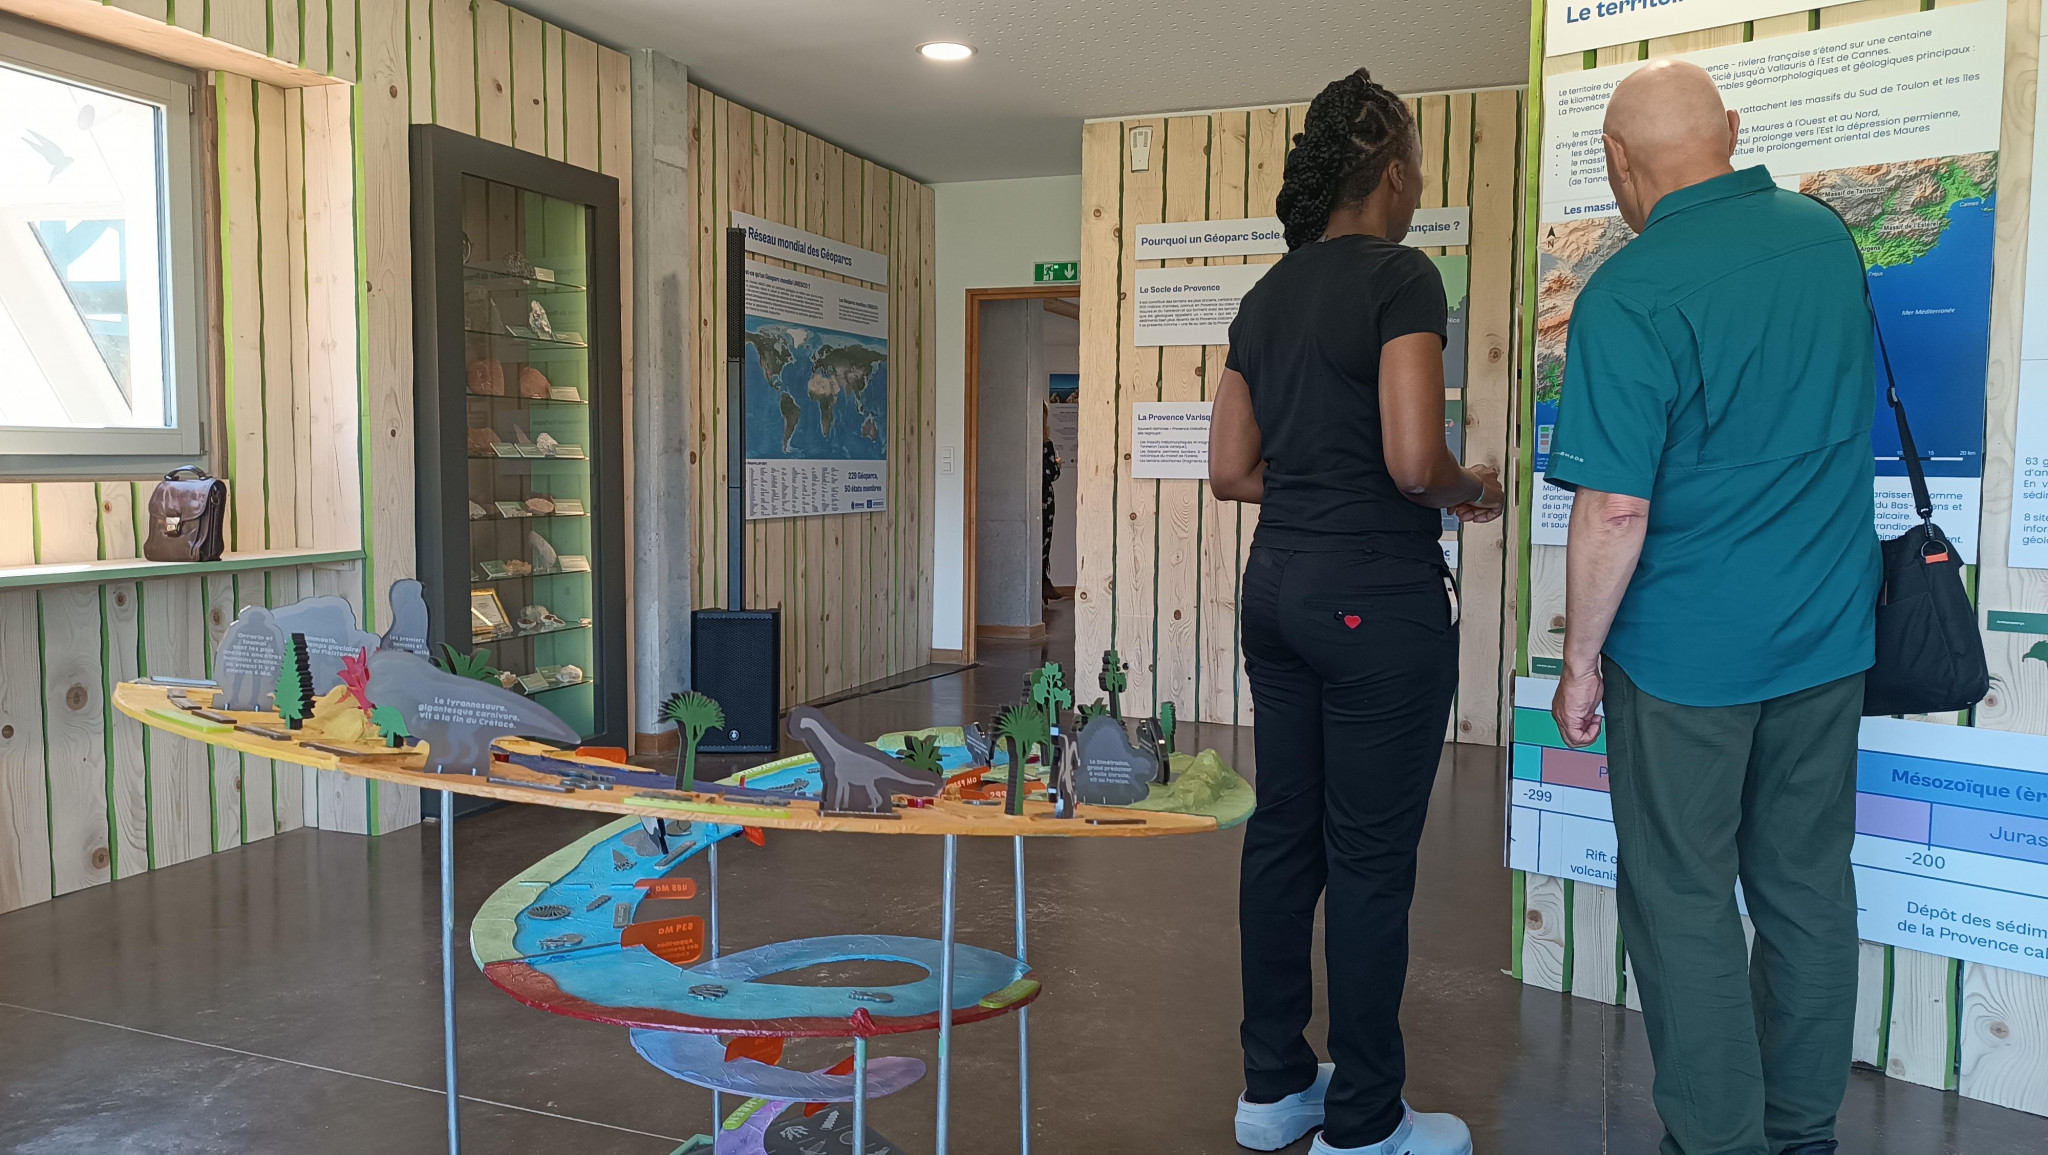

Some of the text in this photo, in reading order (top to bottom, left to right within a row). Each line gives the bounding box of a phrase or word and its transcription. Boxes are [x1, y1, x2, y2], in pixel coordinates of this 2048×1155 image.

[1567, 6, 1591, 24] Le
[1738, 29, 1932, 68] riviera française s'étend sur une centaine
[1768, 60, 1806, 73] Vallauris
[1808, 58, 1815, 67] à
[1836, 53, 1849, 63] de
[1851, 48, 1891, 60] Cannes.
[1746, 46, 1970, 89] géomorphologiques et géologiques principaux
[1558, 80, 1613, 97] Le territoire du
[1740, 73, 1980, 114] rattachent les massifs du Sud de Toulon et les îles
[1558, 92, 1611, 107] de kilomètres
[1568, 103, 1605, 114] Provence
[1751, 108, 1880, 133] Maures à l'Ouest et au Nord,
[1752, 132, 1793, 145] prolonge
[1795, 128, 1814, 137] vers
[1835, 124, 1845, 132] la
[1846, 117, 1901, 132] dépression
[1903, 109, 1961, 125] permienne,
[1572, 130, 1579, 138] le
[1756, 124, 1930, 154] le prolongement oriental des Maures
[1571, 147, 1582, 157] les
[1570, 159, 1578, 167] le
[1570, 164, 1605, 177] le massif
[1568, 177, 1582, 188] (de
[1824, 190, 1845, 198] Massif
[1855, 186, 1886, 195] Tanneron
[1563, 205, 1582, 216] Les
[1453, 221, 1461, 231] ?
[1883, 223, 1903, 232] Massif
[1141, 230, 1280, 247] Pourquoi un Géoparc Socle
[1547, 240, 1554, 249] N
[748, 226, 853, 267] Réseau mondial des Géoparcs
[1139, 284, 1221, 294] Le Socle de Provence
[1902, 309, 1914, 317] Mer
[1137, 413, 1147, 421] La
[1148, 413, 1185, 421] Provence
[2025, 456, 2039, 466] 63
[2023, 479, 2036, 488] En
[1542, 502, 1560, 511] de la
[1875, 501, 1962, 511] du et
[1547, 511, 1567, 521] s'agit
[2023, 513, 2031, 522] 8
[1541, 521, 1549, 529] et
[434, 696, 445, 705] Le
[418, 703, 473, 716] gigantesque
[419, 711, 432, 720] vit
[433, 712, 440, 720] à
[441, 713, 451, 721] la
[452, 714, 464, 723] fin
[466, 716, 477, 724] du
[1891, 768, 2011, 798] Mésozoïque
[1523, 788, 1553, 803] -299
[1585, 848, 1608, 863] Rift
[1905, 851, 1946, 870] -200
[1906, 900, 1957, 922] Dépôt
[1961, 912, 1991, 929] des
[1897, 919, 2019, 955] de la Provence
